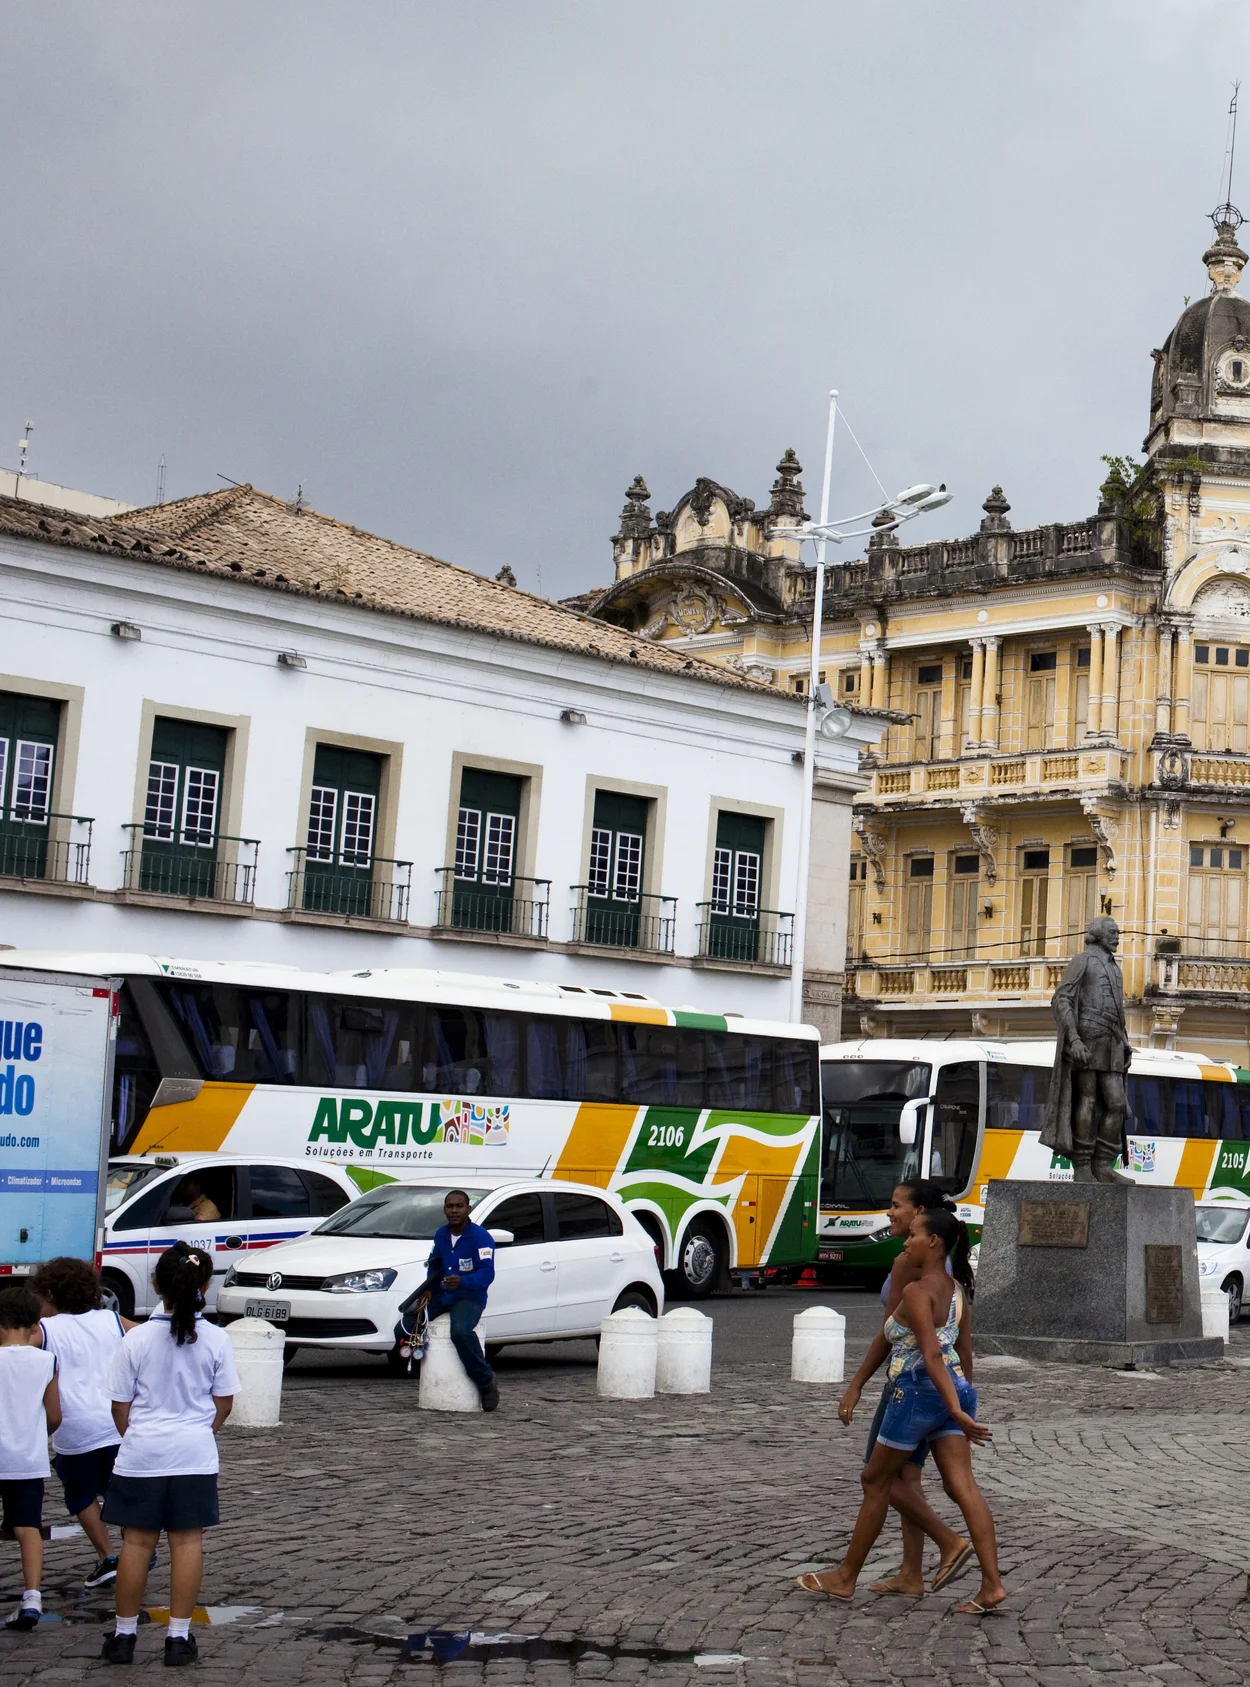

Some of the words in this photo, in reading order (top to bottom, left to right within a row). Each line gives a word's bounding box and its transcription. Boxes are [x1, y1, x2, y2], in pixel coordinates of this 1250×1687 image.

[0, 1020, 43, 1061] ue
[308, 1097, 440, 1149] ARATU
[647, 1125, 685, 1147] 2106
[305, 1146, 354, 1159] Soluções
[359, 1149, 373, 1157] em
[378, 1148, 434, 1160] Transporte
[1221, 1152, 1245, 1169] 2105
[8, 1176, 42, 1185] Climatizador
[51, 1177, 82, 1186] Microondas
[840, 1220, 861, 1228] ARATU
